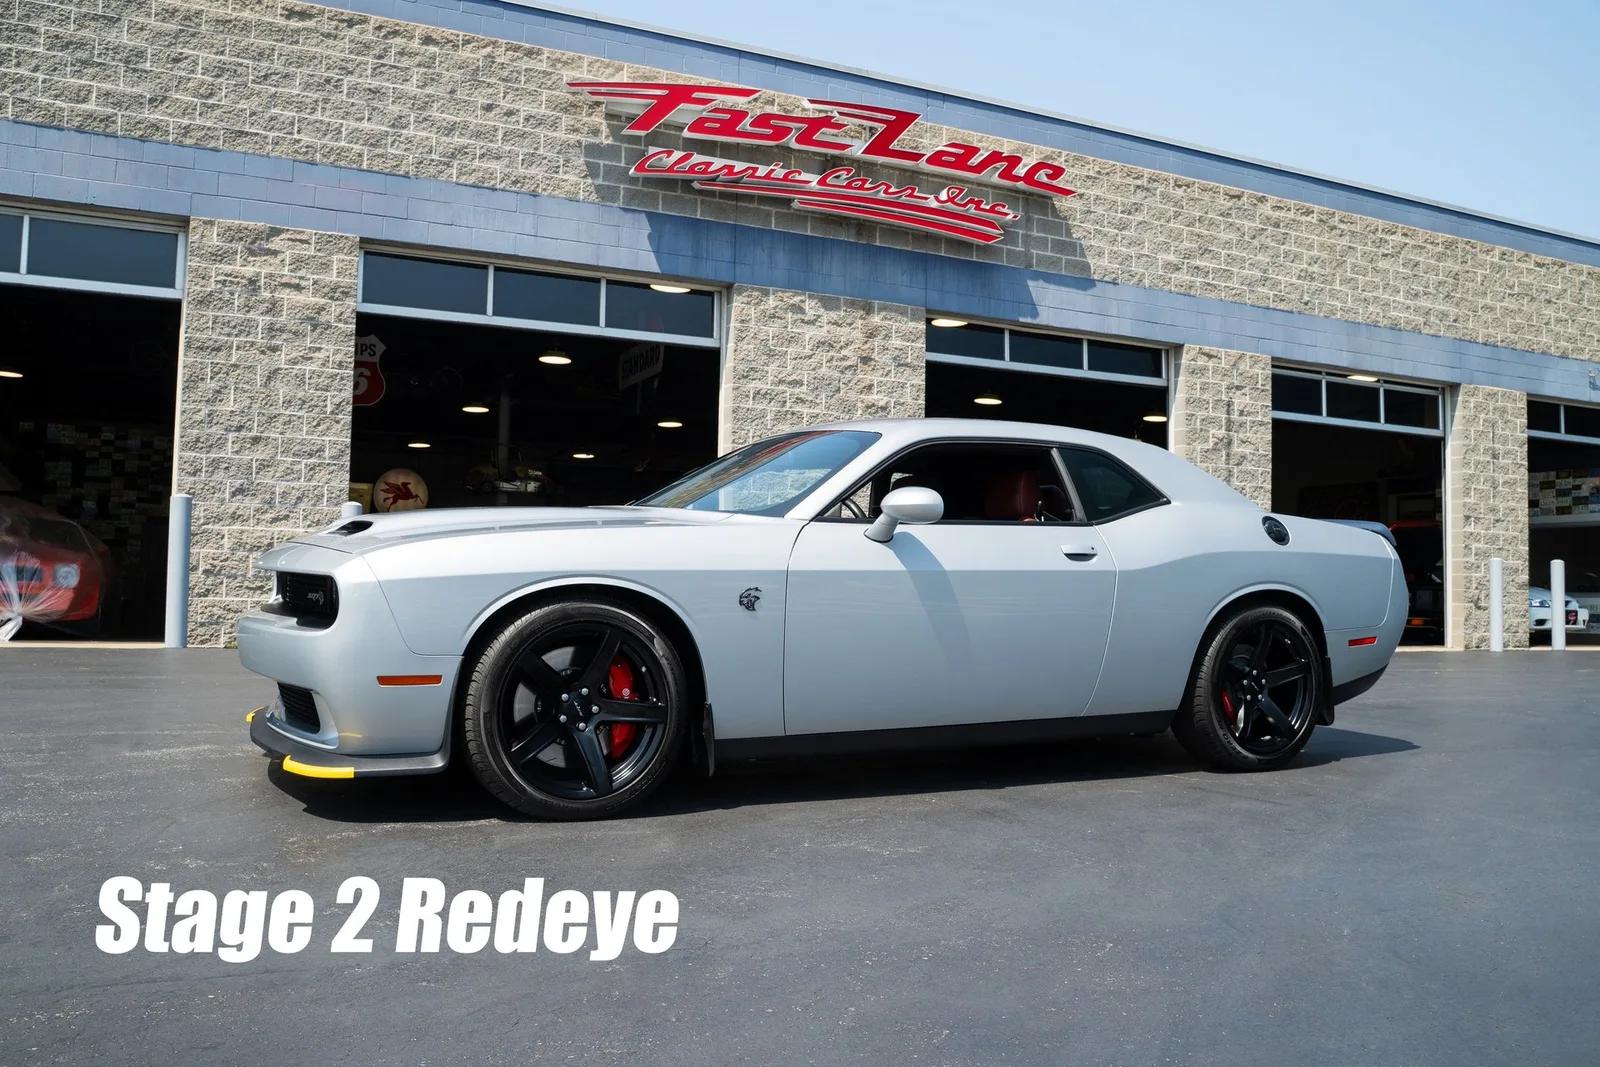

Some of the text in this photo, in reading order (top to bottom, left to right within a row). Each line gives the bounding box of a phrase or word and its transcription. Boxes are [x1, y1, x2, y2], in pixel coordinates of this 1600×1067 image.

[566, 81, 1080, 198] Fast Lane
[629, 149, 813, 187] Classic
[814, 165, 929, 201] Cars
